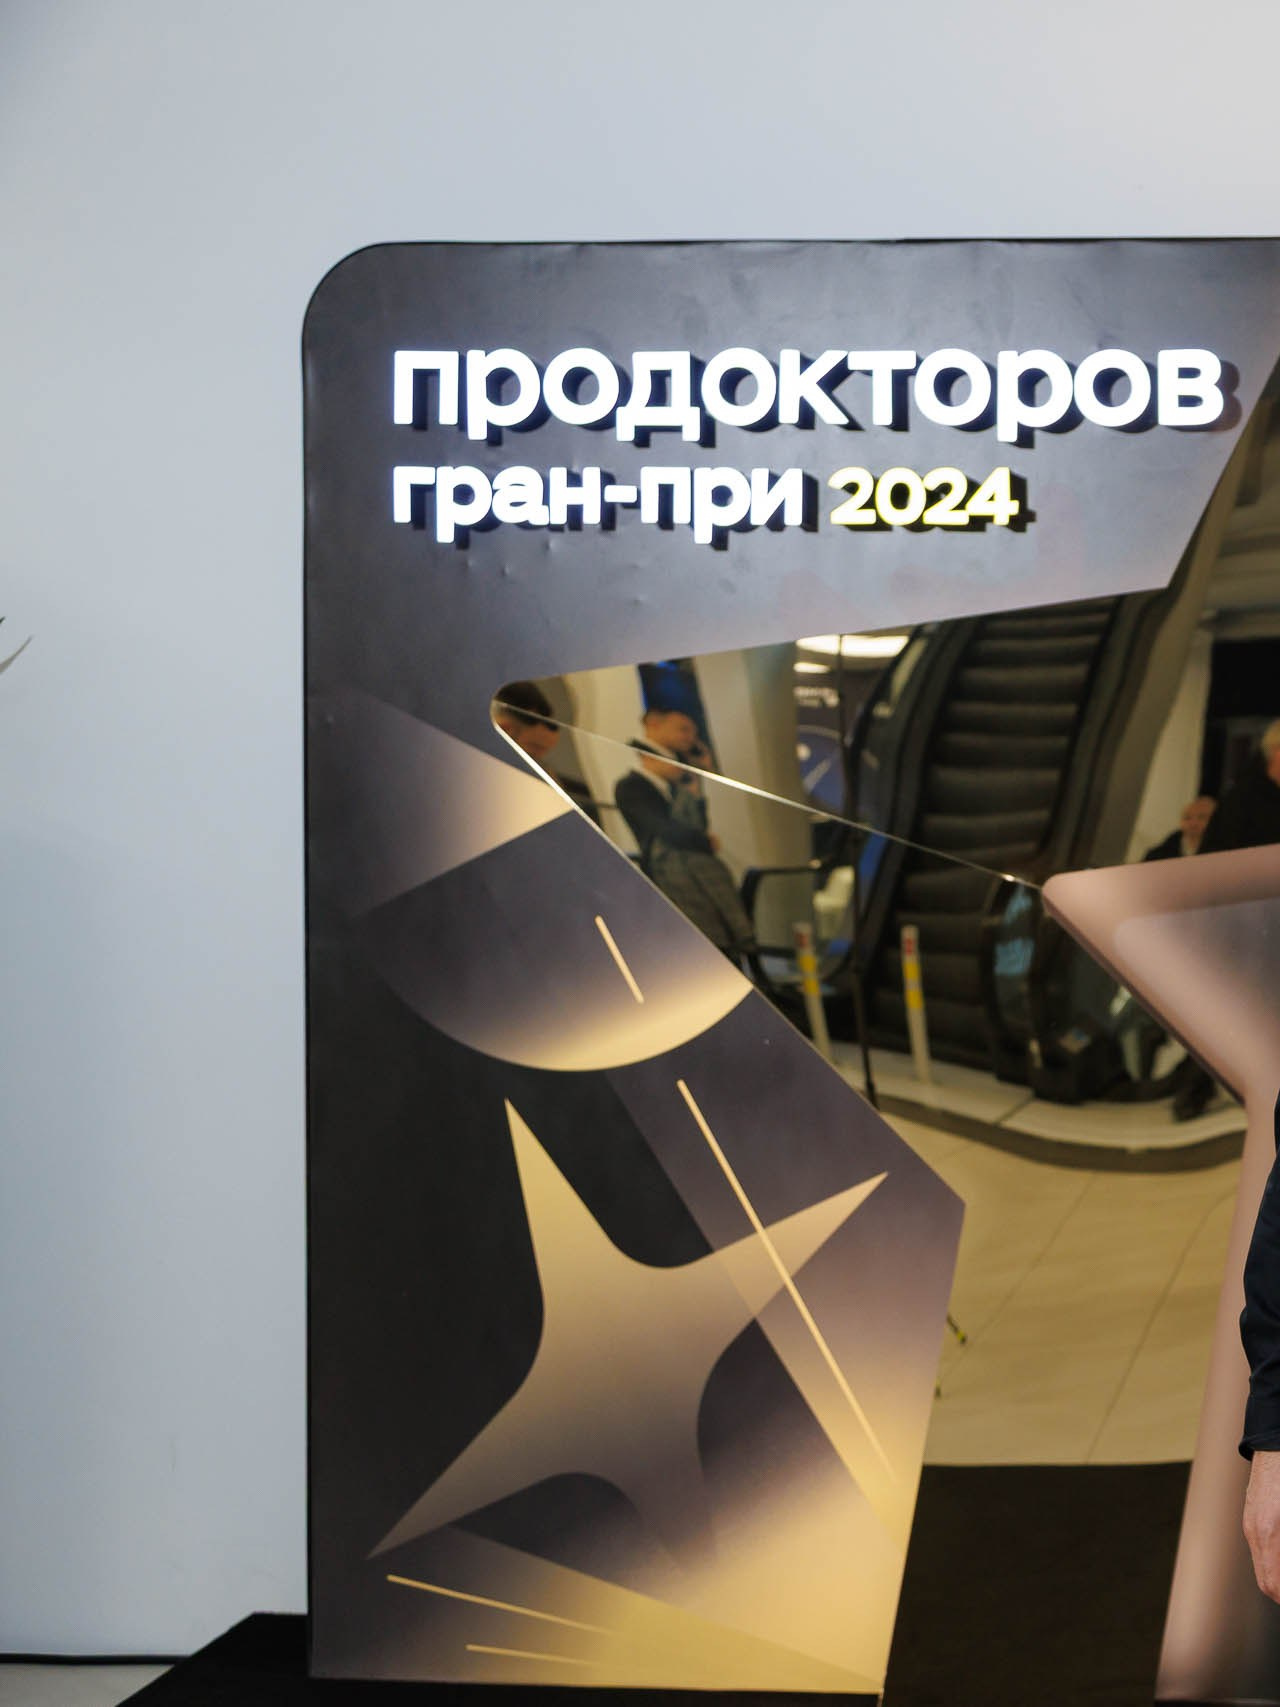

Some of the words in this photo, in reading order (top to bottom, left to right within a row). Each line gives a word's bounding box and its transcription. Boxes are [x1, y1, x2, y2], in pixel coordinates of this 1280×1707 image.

[393, 346, 1224, 443] продокторов
[392, 465, 803, 545] гран-при
[827, 466, 1020, 527] 2024
